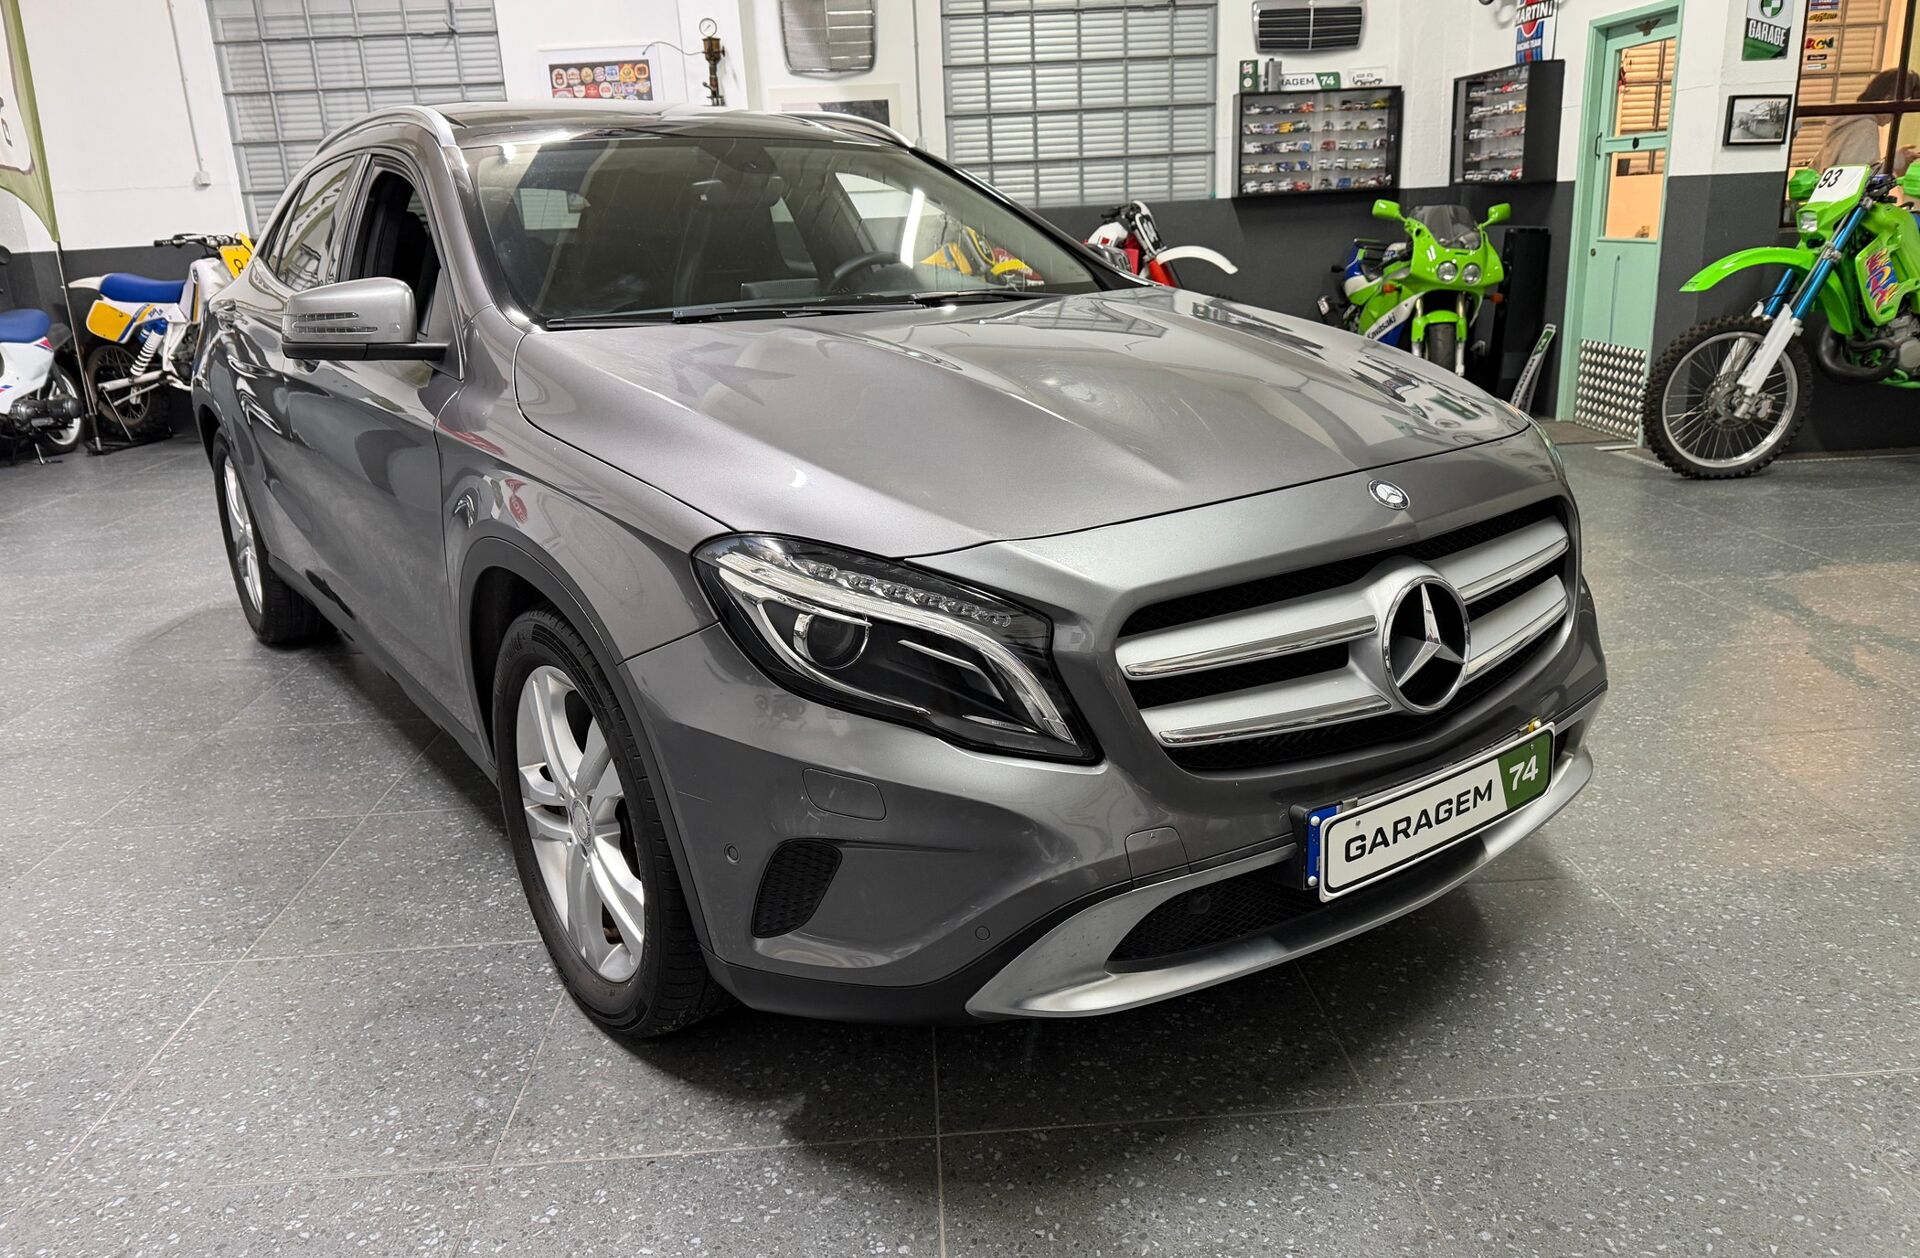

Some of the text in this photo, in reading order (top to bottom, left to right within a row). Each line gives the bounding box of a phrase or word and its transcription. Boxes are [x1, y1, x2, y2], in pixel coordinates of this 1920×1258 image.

[1516, 0, 1553, 25] MARTINI
[1748, 19, 1787, 47] GARAGE
[1280, 76, 1335, 86] AGEM 74
[1818, 168, 1843, 189] 93
[1344, 754, 1539, 863] GARAGEM 74
